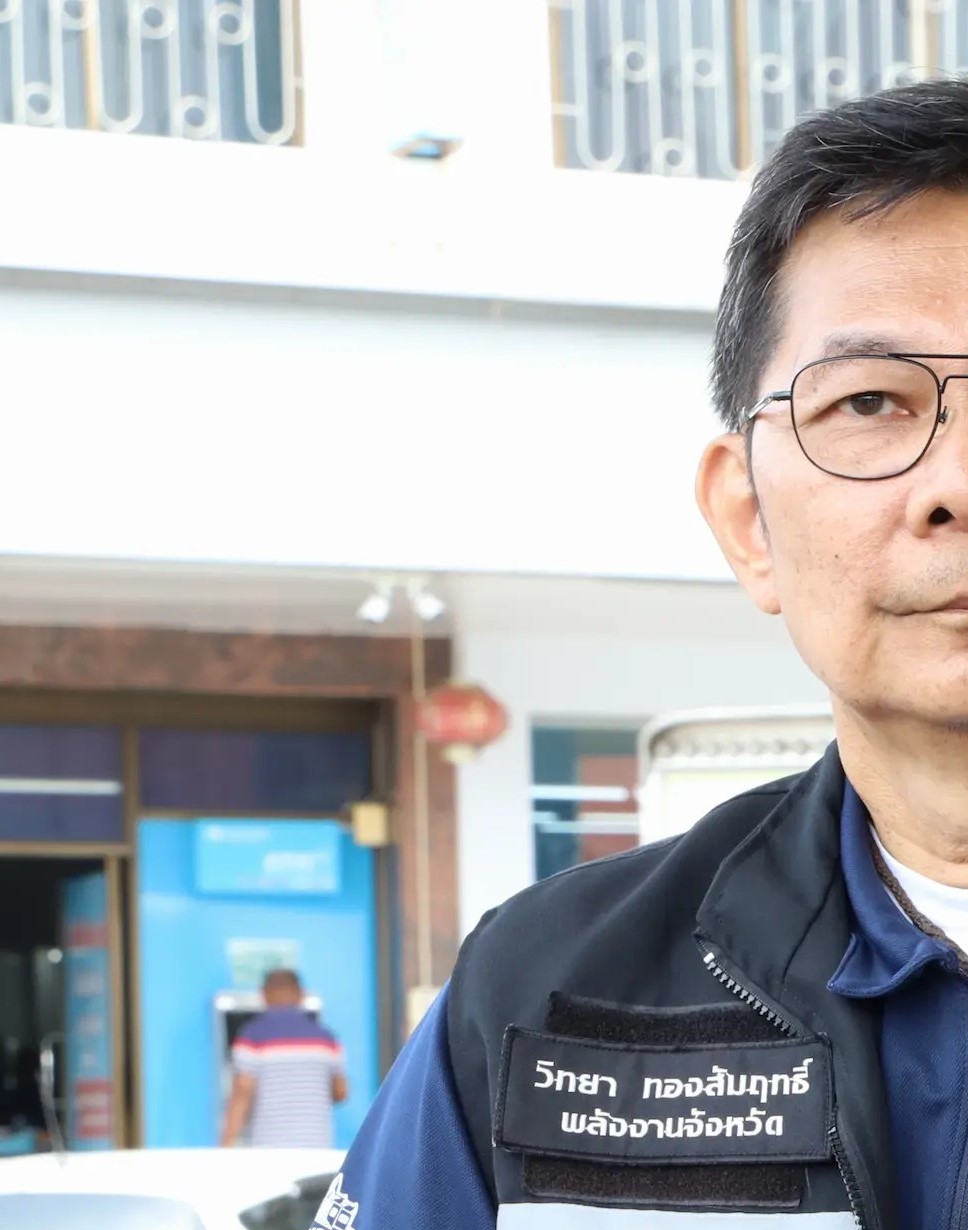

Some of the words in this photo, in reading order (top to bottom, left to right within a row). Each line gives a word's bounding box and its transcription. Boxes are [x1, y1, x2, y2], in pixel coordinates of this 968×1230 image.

[533, 1058, 618, 1098] วิทยา
[642, 1057, 814, 1103] ทองสัมฤทธิ์
[561, 1107, 784, 1139] พลังงานจังหวัด
